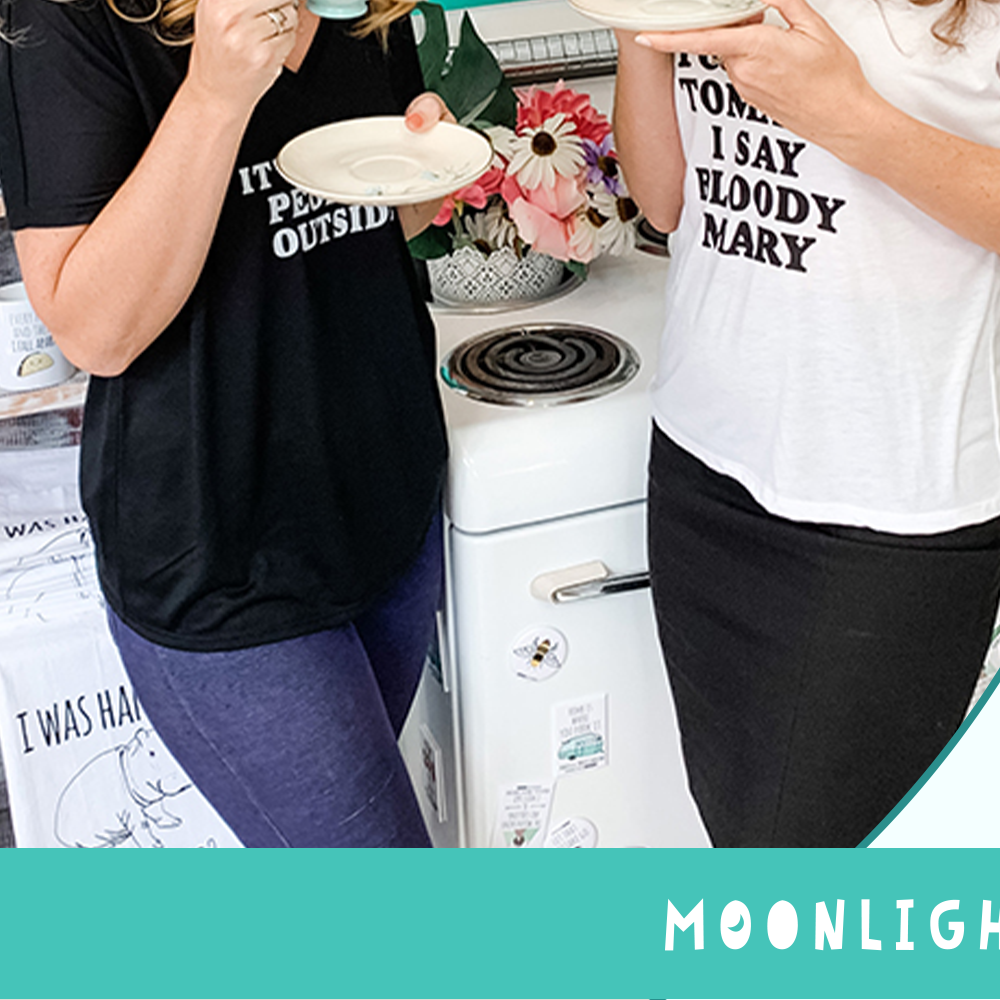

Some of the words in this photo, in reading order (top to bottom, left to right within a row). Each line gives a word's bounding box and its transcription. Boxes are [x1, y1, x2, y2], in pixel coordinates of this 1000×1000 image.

[711, 125, 725, 160] I
[734, 130, 806, 178] SAY
[272, 205, 394, 258] OUTSID
[702, 212, 816, 273] MARY
[16, 711, 34, 754] I
[36, 695, 92, 747] WAS
